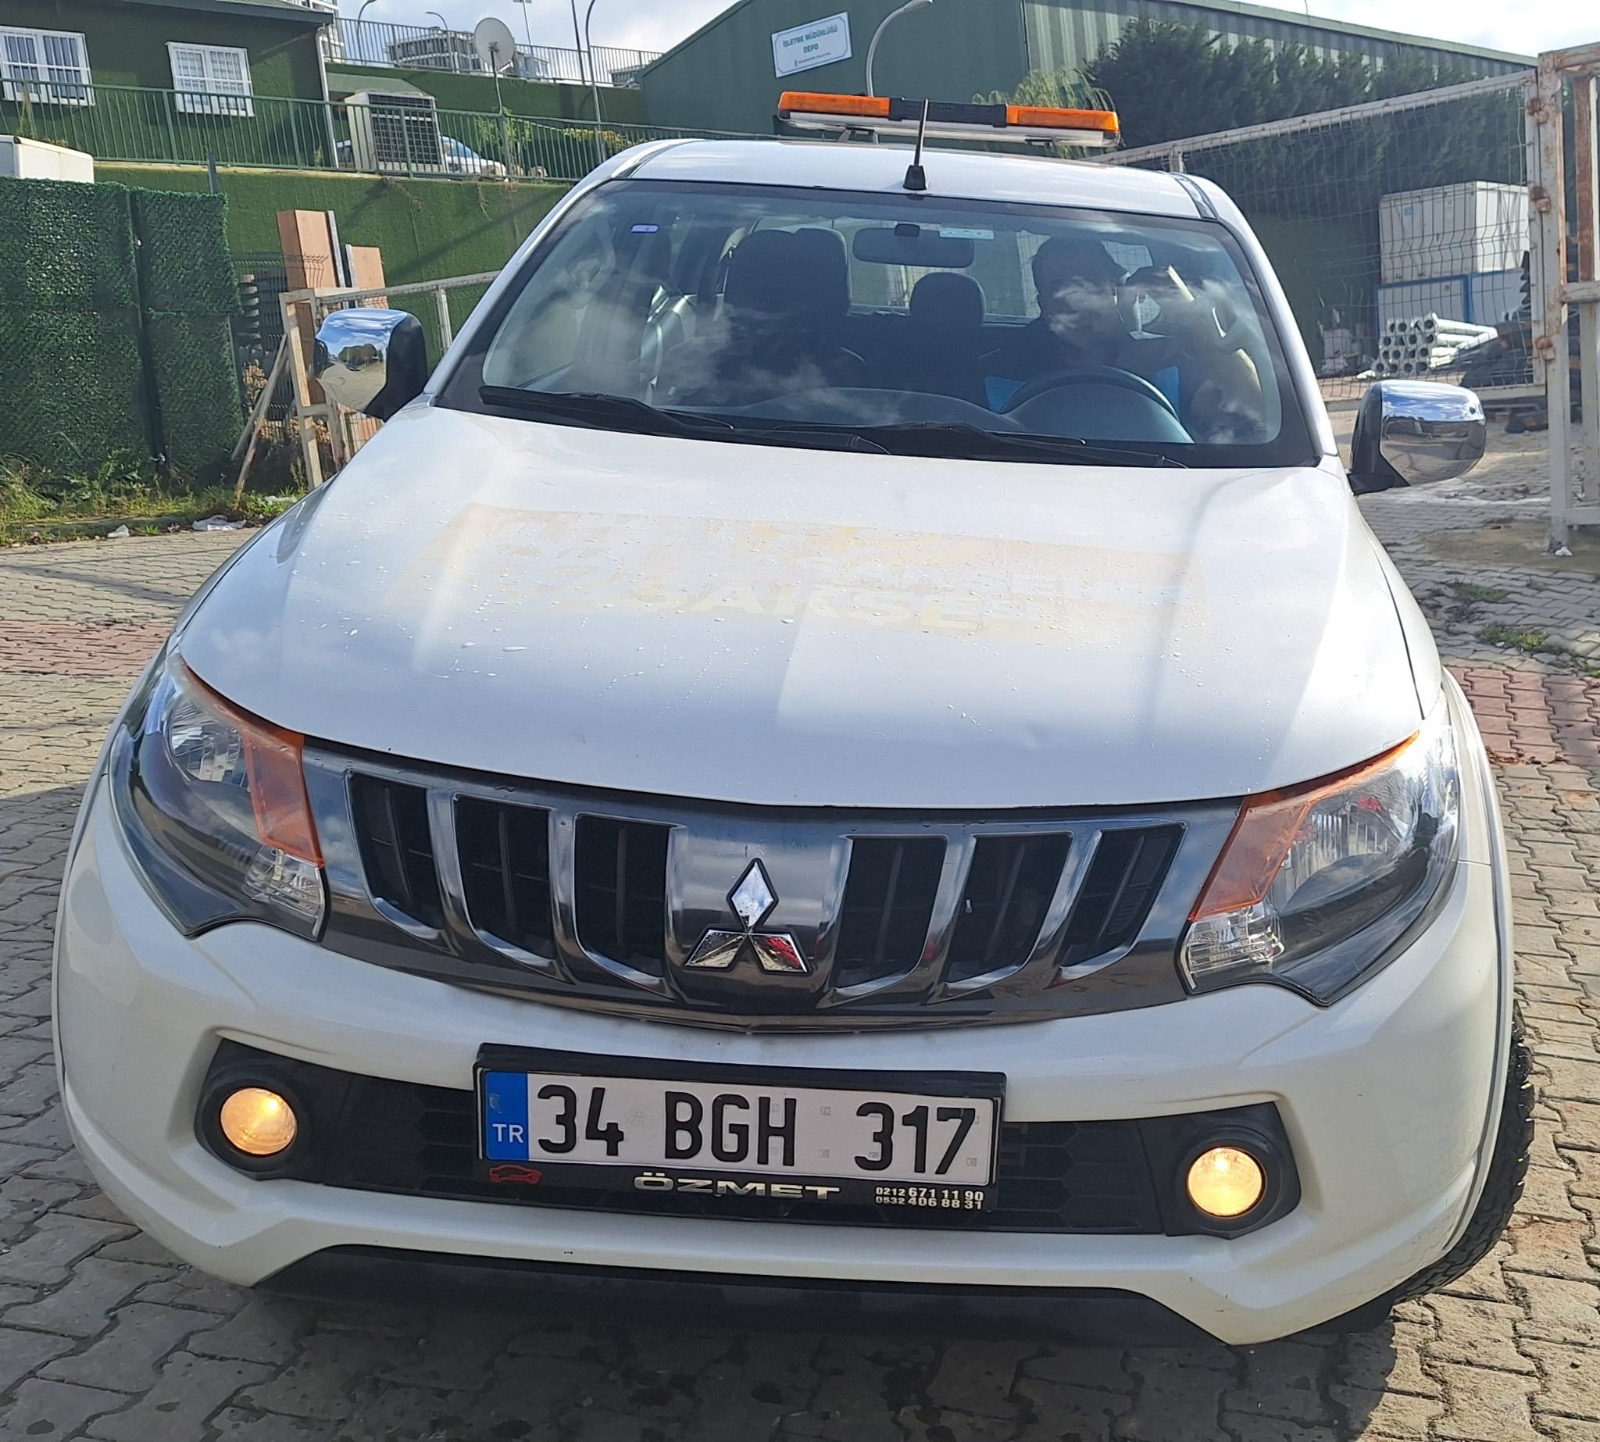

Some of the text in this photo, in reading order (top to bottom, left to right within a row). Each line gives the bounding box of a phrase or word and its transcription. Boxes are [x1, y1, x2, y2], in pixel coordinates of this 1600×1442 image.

[803, 43, 819, 53] DEPO
[491, 1123, 524, 1143] TR
[537, 1084, 977, 1175] 34 BGH 317
[633, 1172, 841, 1201] ÖZMET
[875, 1186, 984, 1202] 0212 671 11 90
[875, 1196, 984, 1210] 0532 406 88 31
